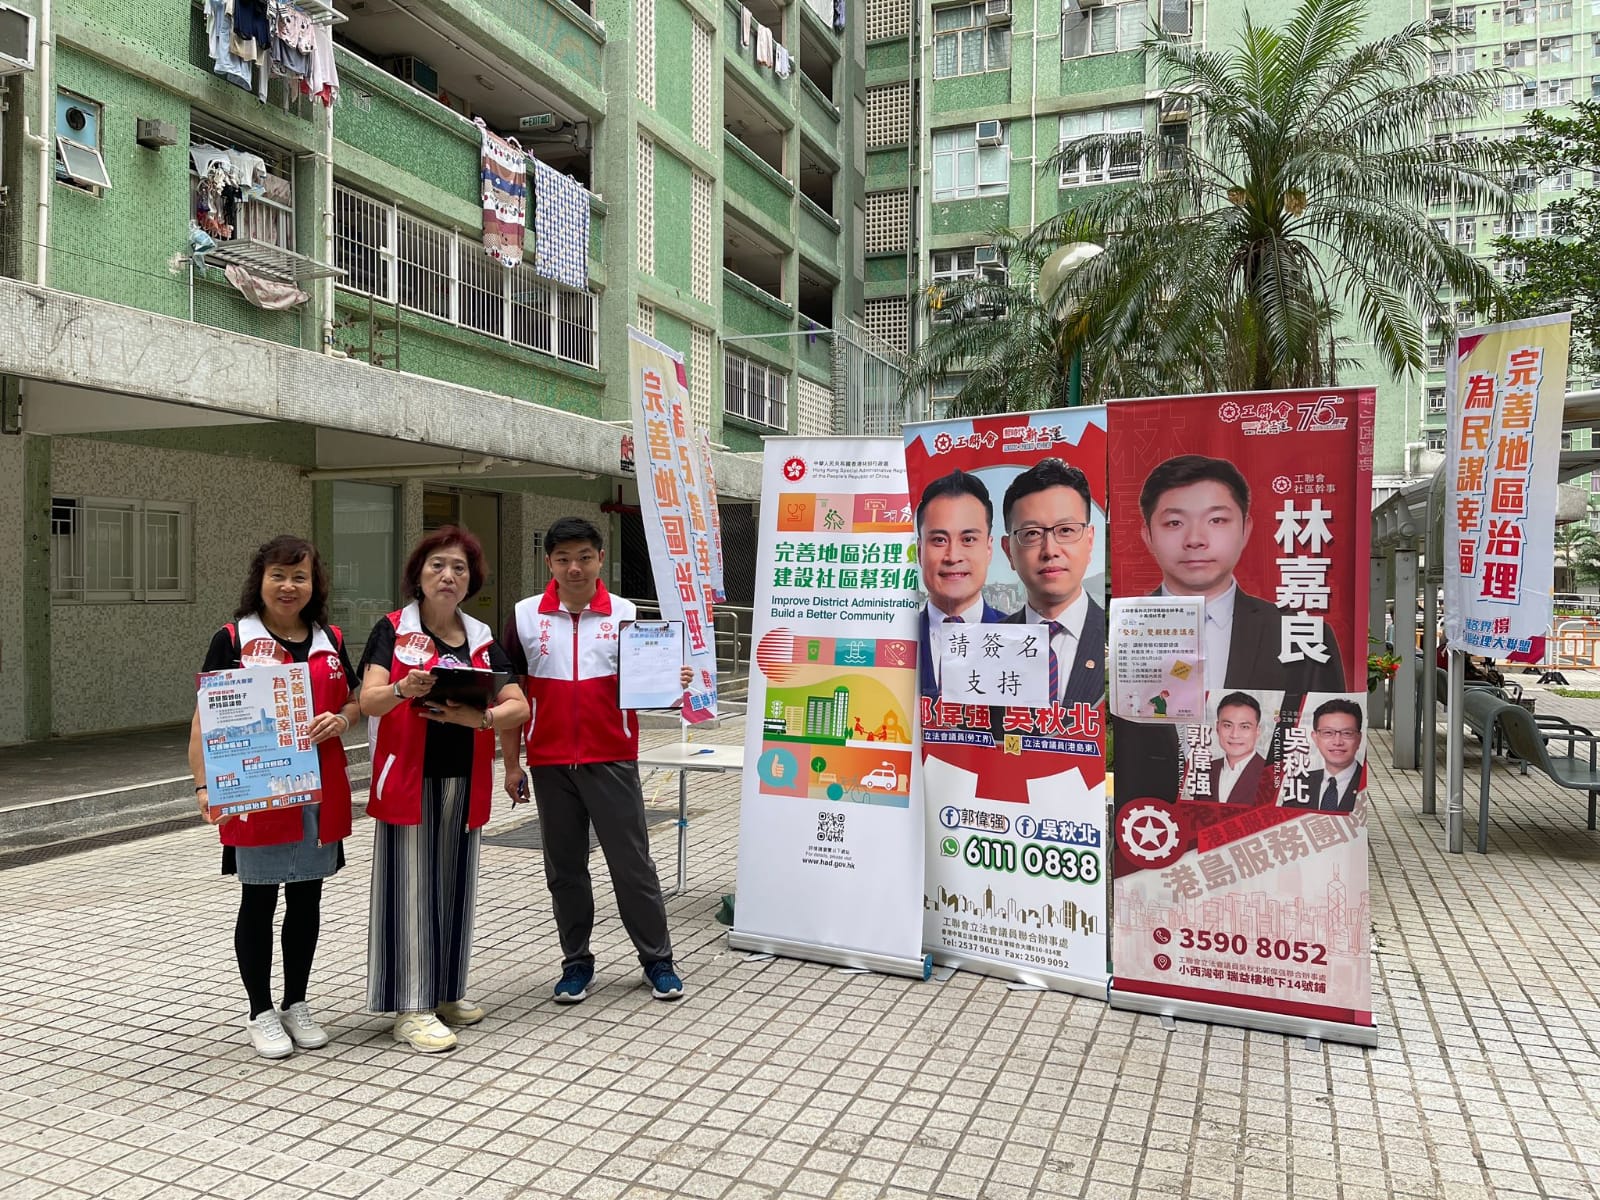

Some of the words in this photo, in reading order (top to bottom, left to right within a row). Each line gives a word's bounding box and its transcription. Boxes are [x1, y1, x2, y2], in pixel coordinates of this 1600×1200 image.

[529, 117, 540, 126] EXIT
[1241, 401, 1293, 418] 工聯會
[954, 431, 998, 449] 工聯會
[1295, 474, 1325, 483] 工聯會
[1457, 374, 1494, 575] 為民謀幸福
[1480, 349, 1539, 600] 完善地區治理
[1295, 484, 1336, 494] 社區幹事
[774, 541, 903, 564] 完善地區治理
[1274, 498, 1333, 664] 林嘉良
[771, 595, 810, 607] Improve
[813, 596, 848, 607] District
[851, 598, 919, 609] Administration
[771, 608, 795, 618] Build
[806, 609, 837, 619] Better
[839, 610, 895, 623] Community
[539, 619, 551, 656] 林嘉良
[595, 632, 617, 641] 工聯會
[948, 632, 1040, 659] 請簽名
[965, 669, 1022, 696] 支持
[273, 677, 293, 746] 為民謀幸福
[289, 667, 312, 752] 完善地區治理
[1003, 700, 1101, 738] 吳秋北
[924, 731, 993, 745] 立法會議員(勞工界)
[1023, 738, 1096, 754] 立法會議員(港島東)
[1273, 727, 1281, 738] NG
[1186, 724, 1212, 797] 郭偉强
[1273, 739, 1281, 759] CHAU
[1282, 728, 1310, 804] 吳秋北
[1041, 818, 1097, 845] 吳秋北
[802, 858, 855, 869] www.had.gov.hk
[966, 838, 1015, 870] 6111
[1023, 846, 1099, 882] 0838
[943, 917, 1068, 949] 工聯會立法會議員聯合辦事處
[1179, 927, 1248, 955] 3590
[1255, 937, 1328, 966] 8052
[942, 937, 957, 947] Tel:
[958, 940, 978, 951] 2537
[980, 945, 1000, 956] 9618
[1005, 949, 1023, 960] Fax:
[1024, 953, 1046, 964] 2509
[1047, 957, 1070, 969] 9092
[1178, 965, 1224, 981] 小西灣邨
